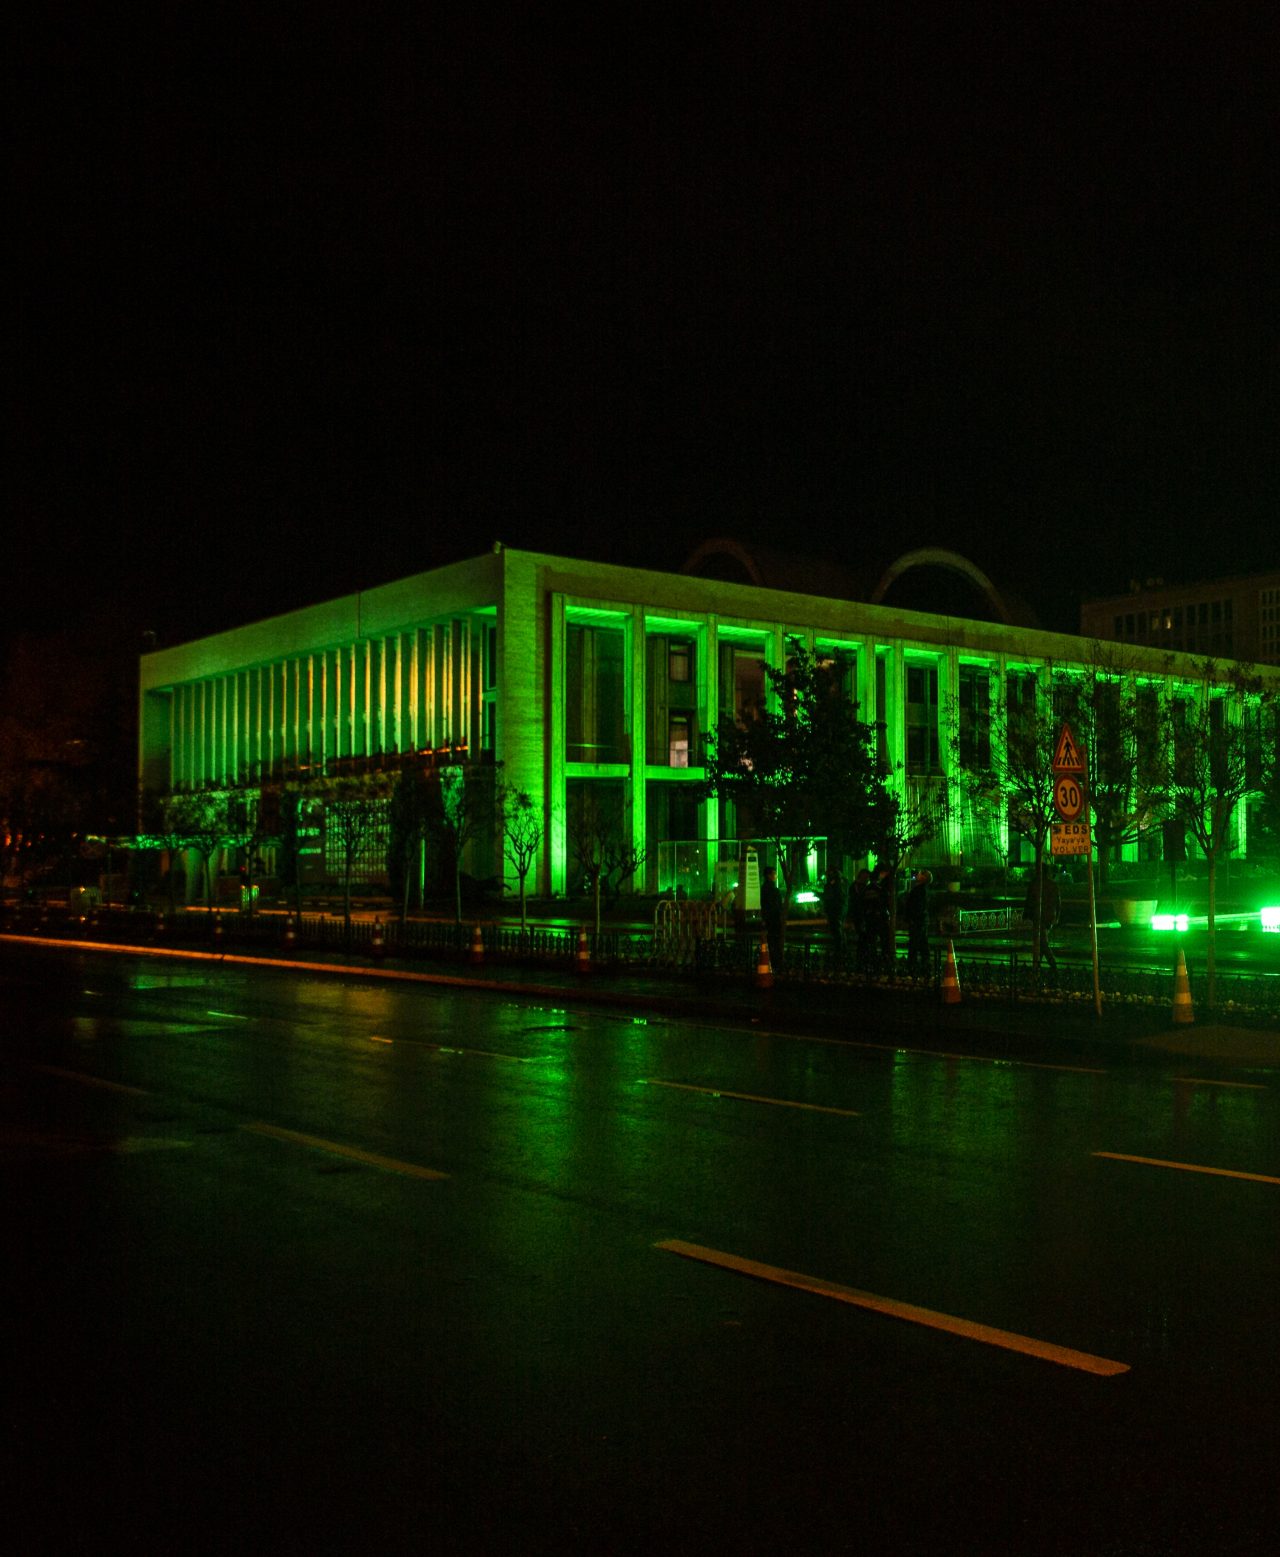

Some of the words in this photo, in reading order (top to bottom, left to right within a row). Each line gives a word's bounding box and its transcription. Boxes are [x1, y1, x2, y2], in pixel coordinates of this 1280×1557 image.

[1060, 786, 1078, 807] 30
[1065, 825, 1088, 835] EDS
[1072, 845, 1089, 853] VER
